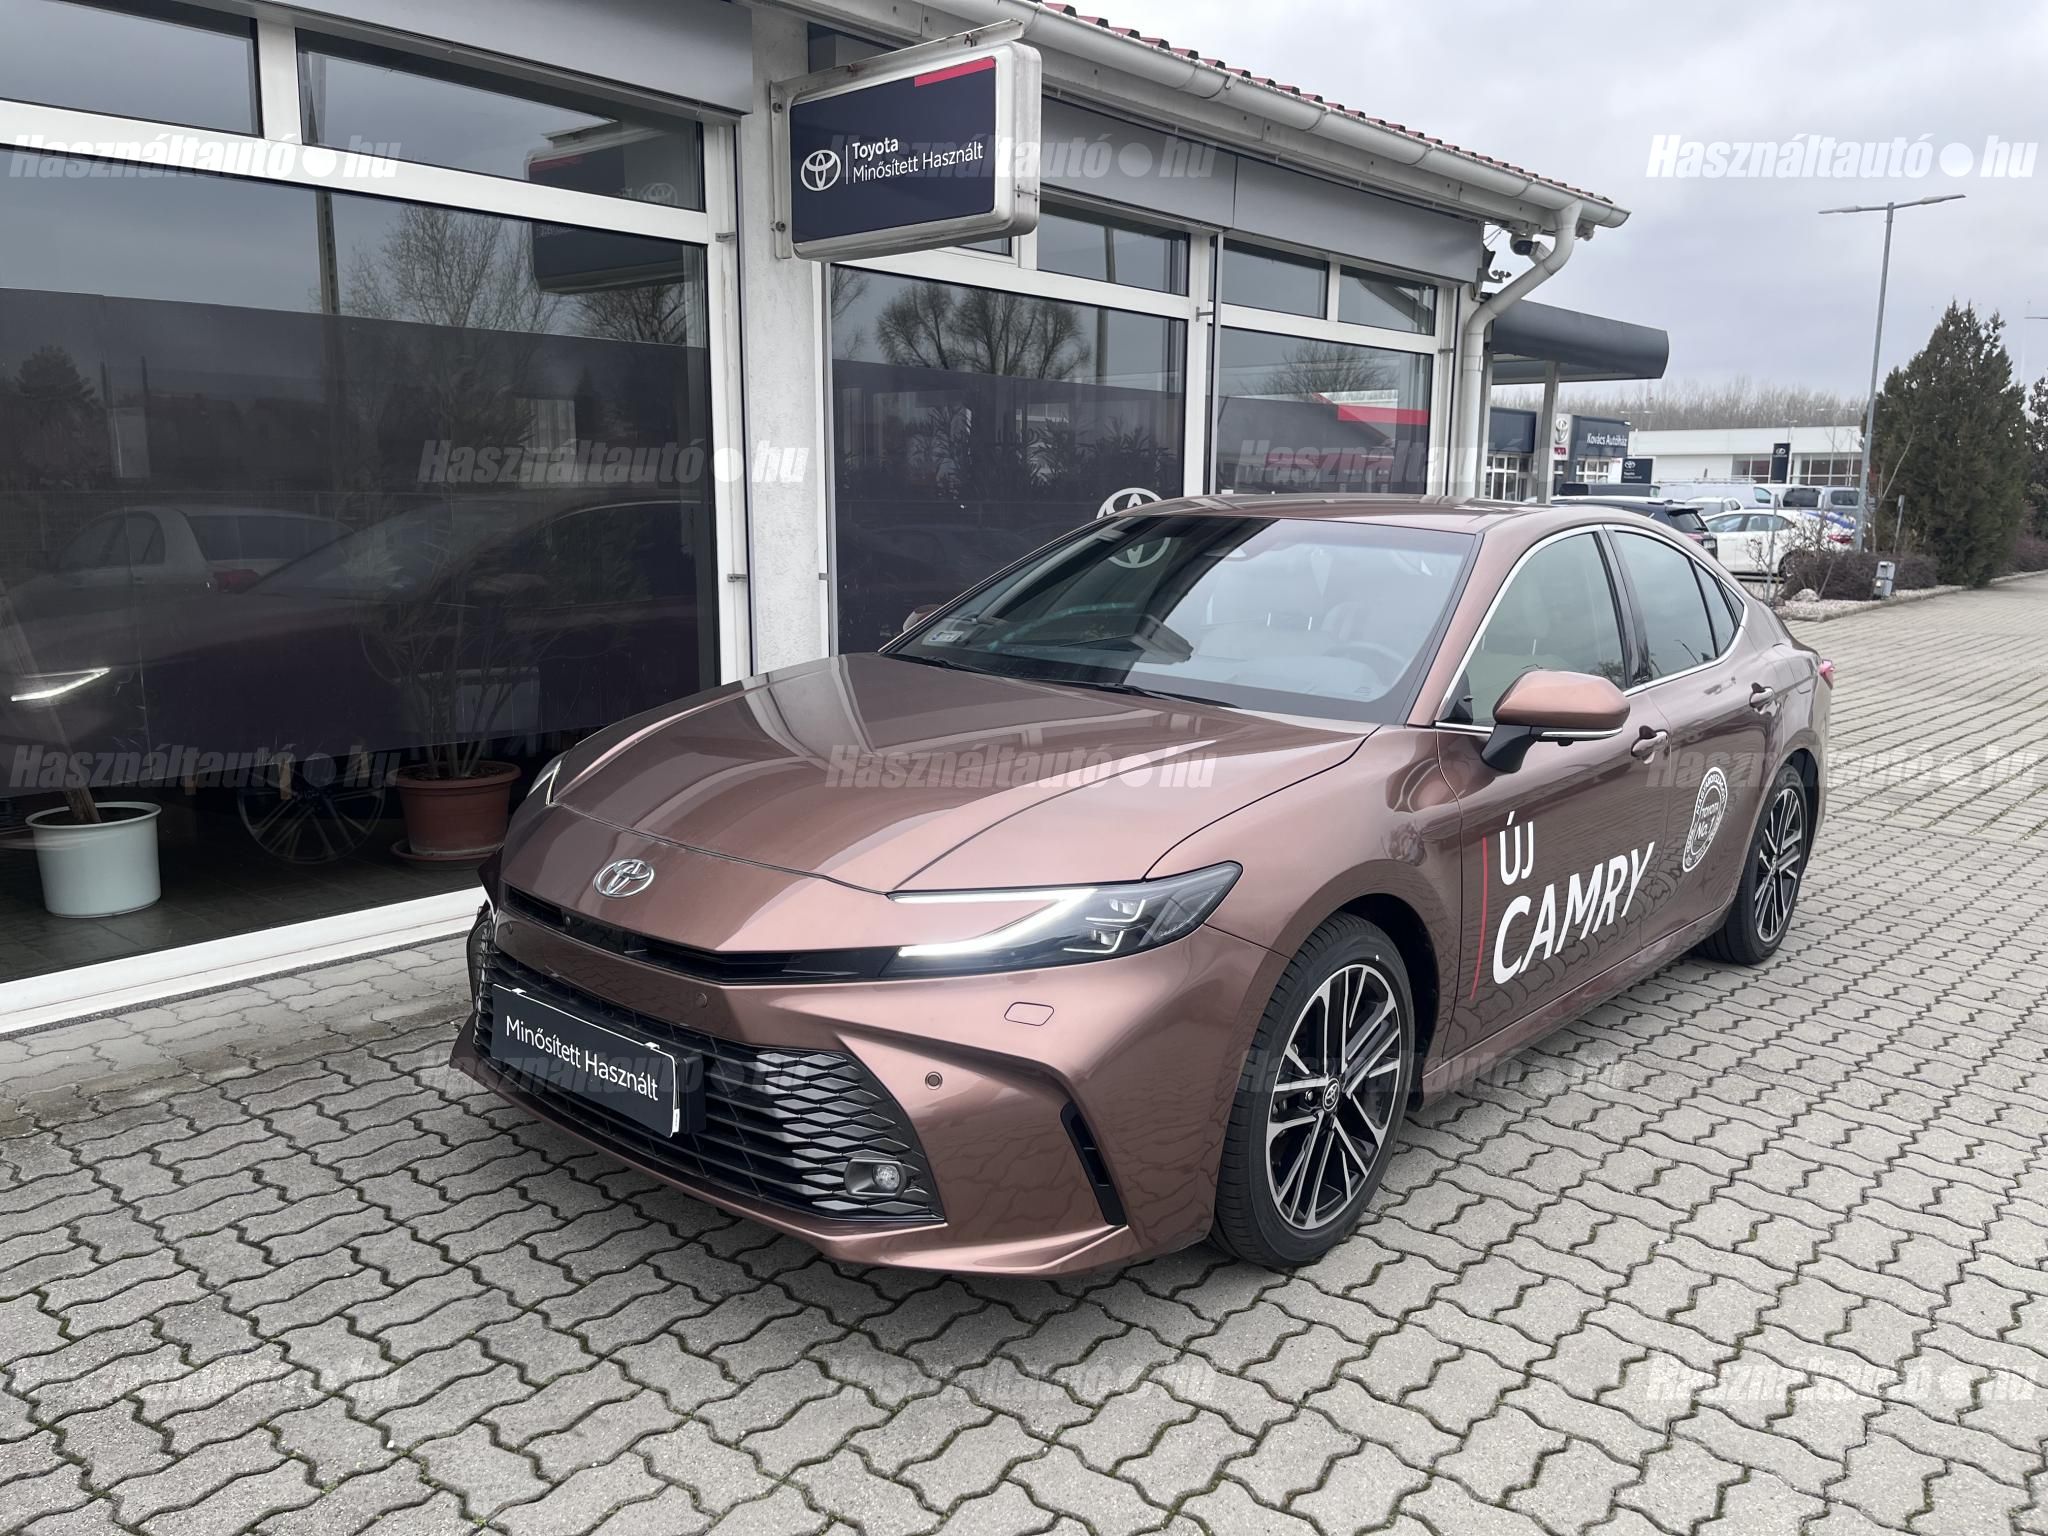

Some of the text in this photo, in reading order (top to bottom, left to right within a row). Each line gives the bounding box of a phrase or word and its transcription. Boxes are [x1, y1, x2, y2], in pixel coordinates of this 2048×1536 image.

[852, 137, 899, 160] Toyota
[853, 141, 983, 184] Minősített Használt
[1587, 432, 1605, 445] Kovács
[1499, 810, 1535, 886] ÚJ
[1492, 841, 1655, 985] CAMRY
[506, 1015, 659, 1101] Minősített Használt
